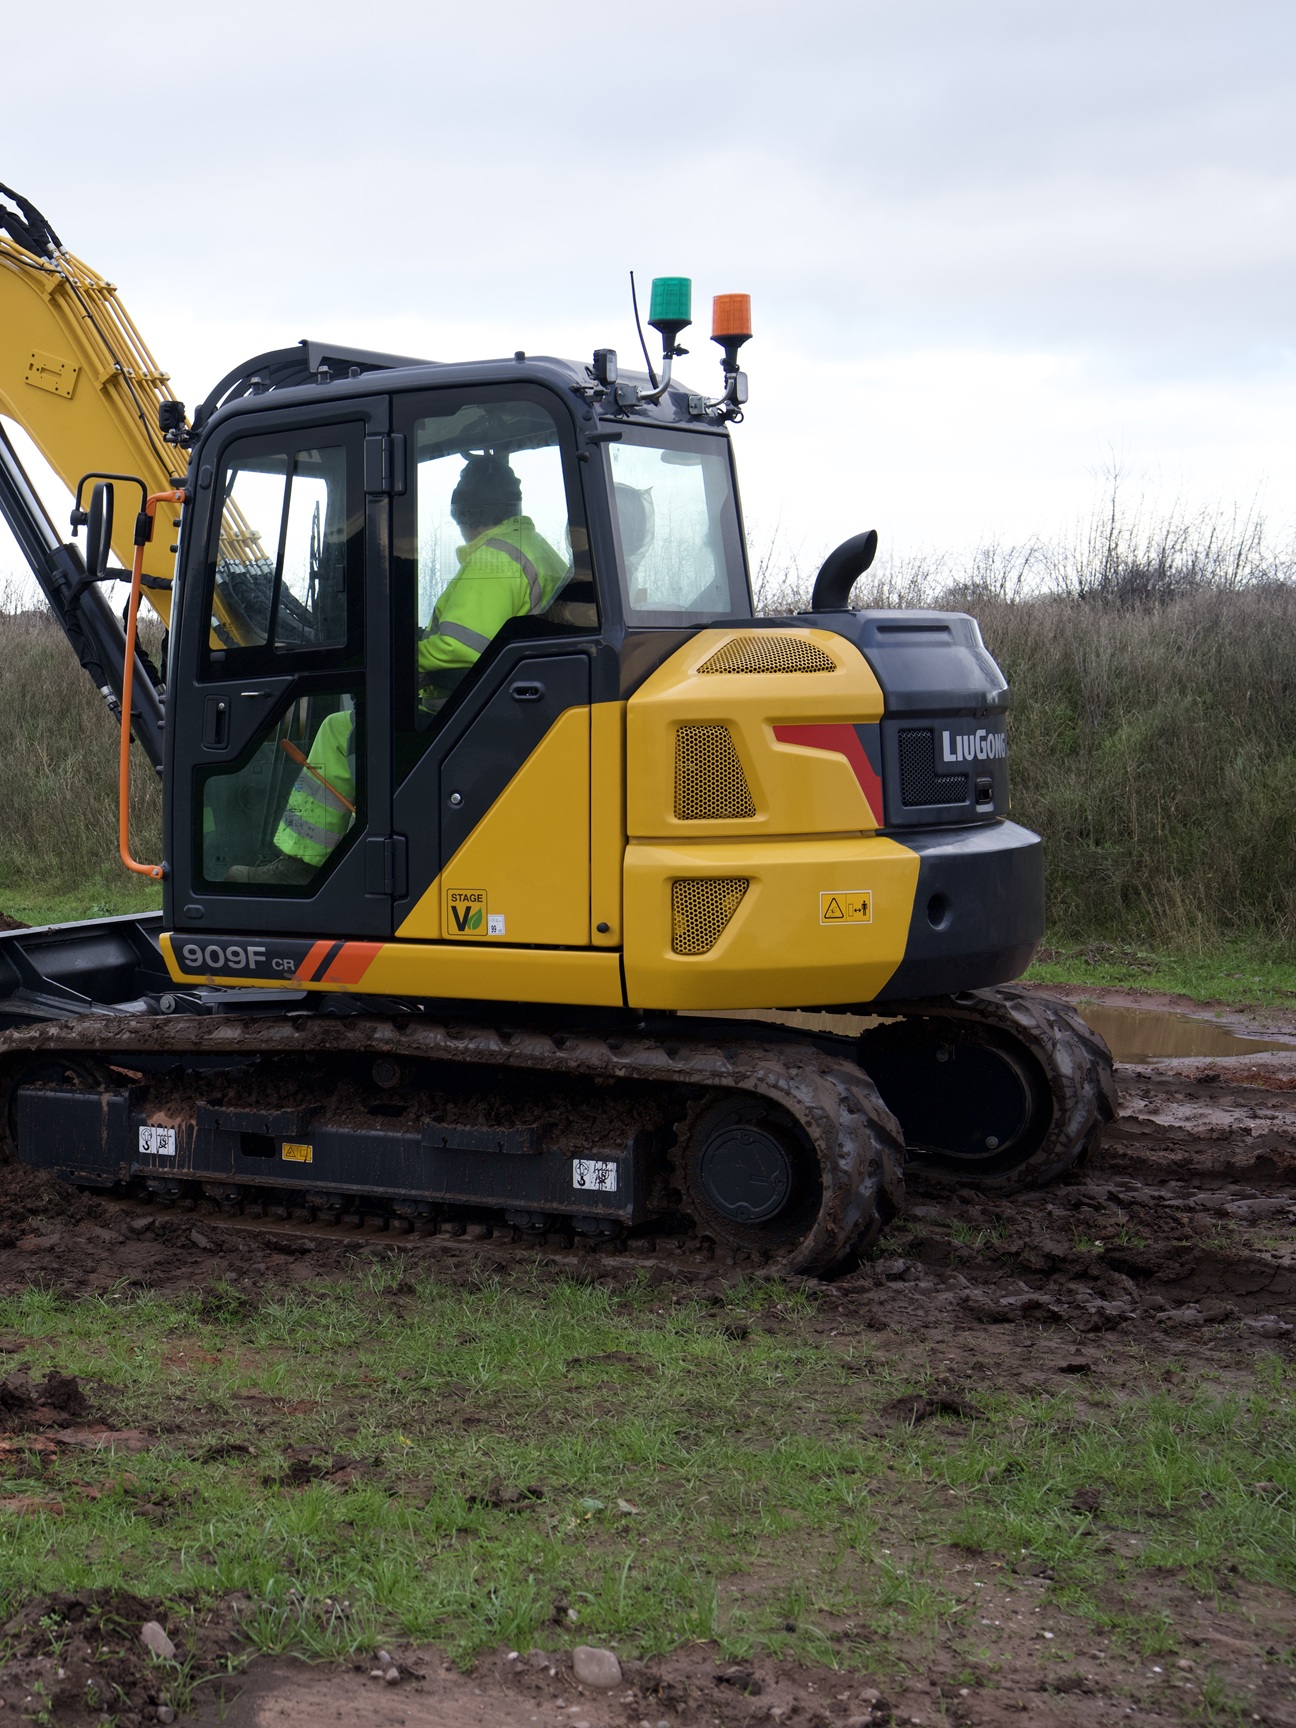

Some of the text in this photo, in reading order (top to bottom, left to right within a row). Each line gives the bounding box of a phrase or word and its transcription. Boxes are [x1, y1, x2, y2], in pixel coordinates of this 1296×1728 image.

[451, 893, 483, 903] STAGE
[450, 905, 472, 932] V
[182, 944, 295, 971] 909F CR
